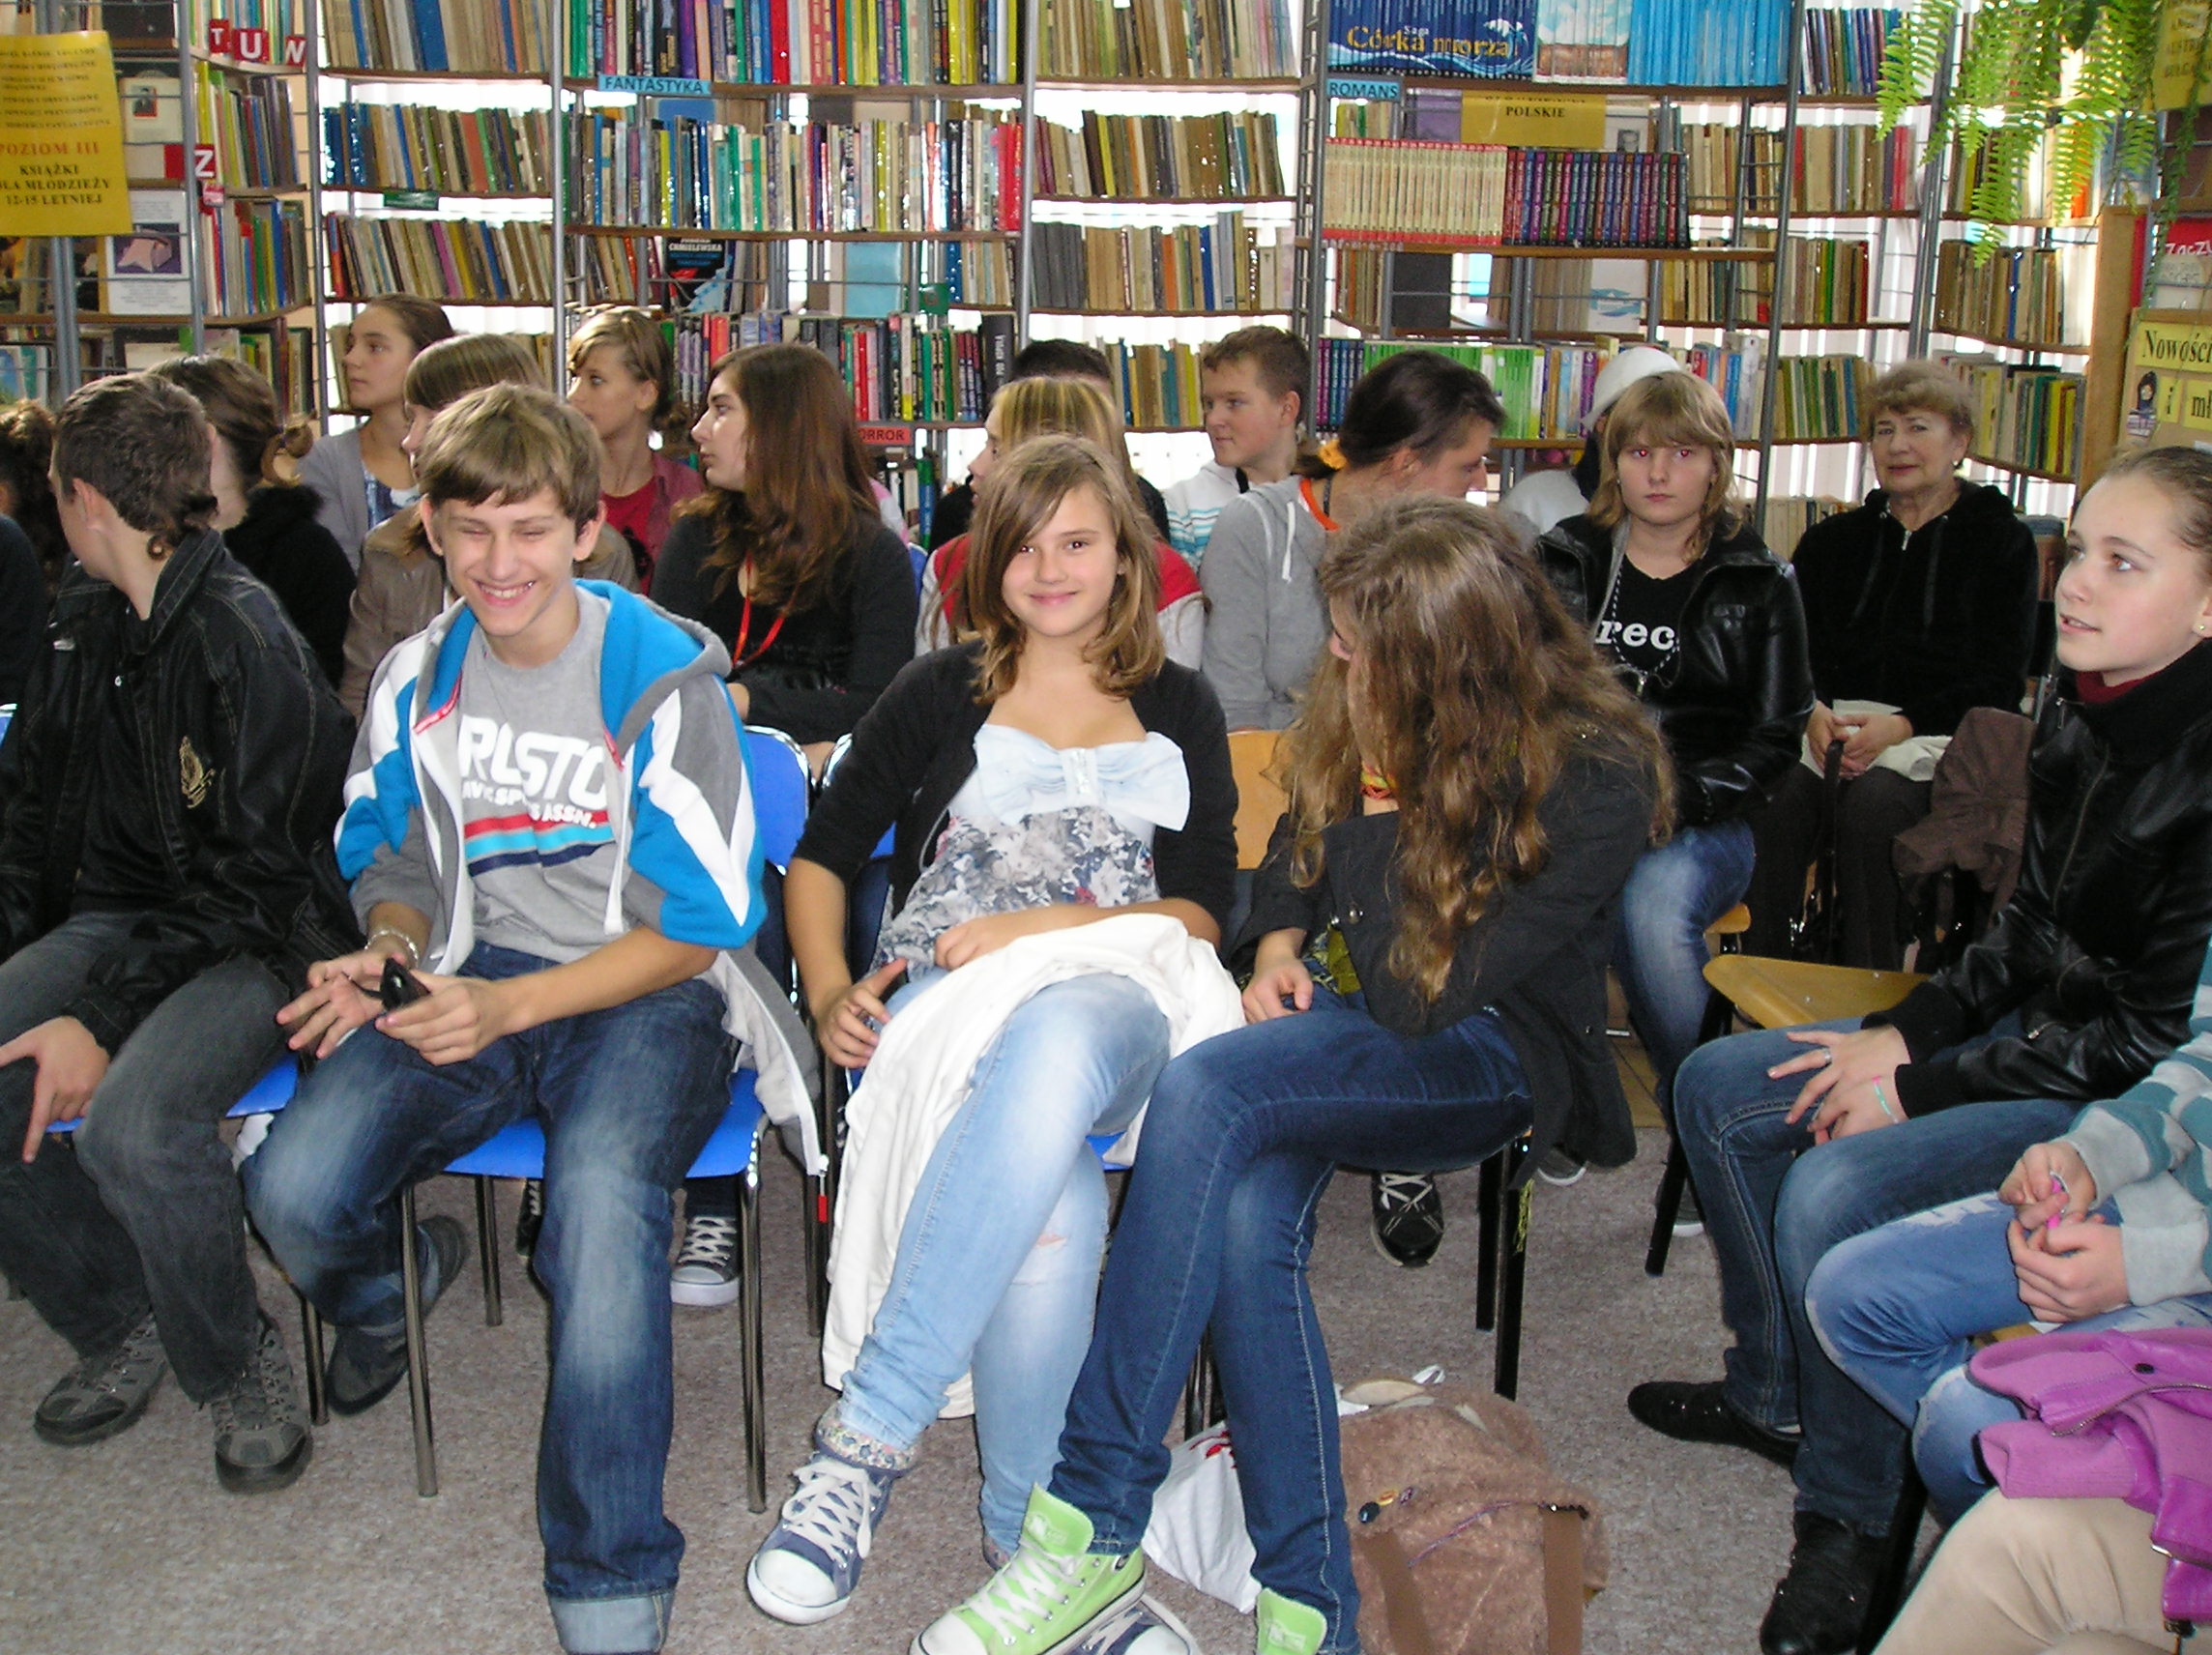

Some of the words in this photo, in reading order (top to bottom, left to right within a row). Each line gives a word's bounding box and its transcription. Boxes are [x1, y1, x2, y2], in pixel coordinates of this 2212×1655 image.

[211, 28, 223, 45] T
[240, 32, 262, 59] U
[1347, 25, 1426, 52] Córka
[605, 77, 704, 94] FANTASTYKA
[1329, 82, 1398, 98] ROMANS
[1505, 105, 1566, 119] POLSKIE
[76, 140, 100, 156] III
[195, 148, 215, 178] Z
[42, 193, 102, 205] LETNIEJ
[1595, 619, 1675, 651] rec
